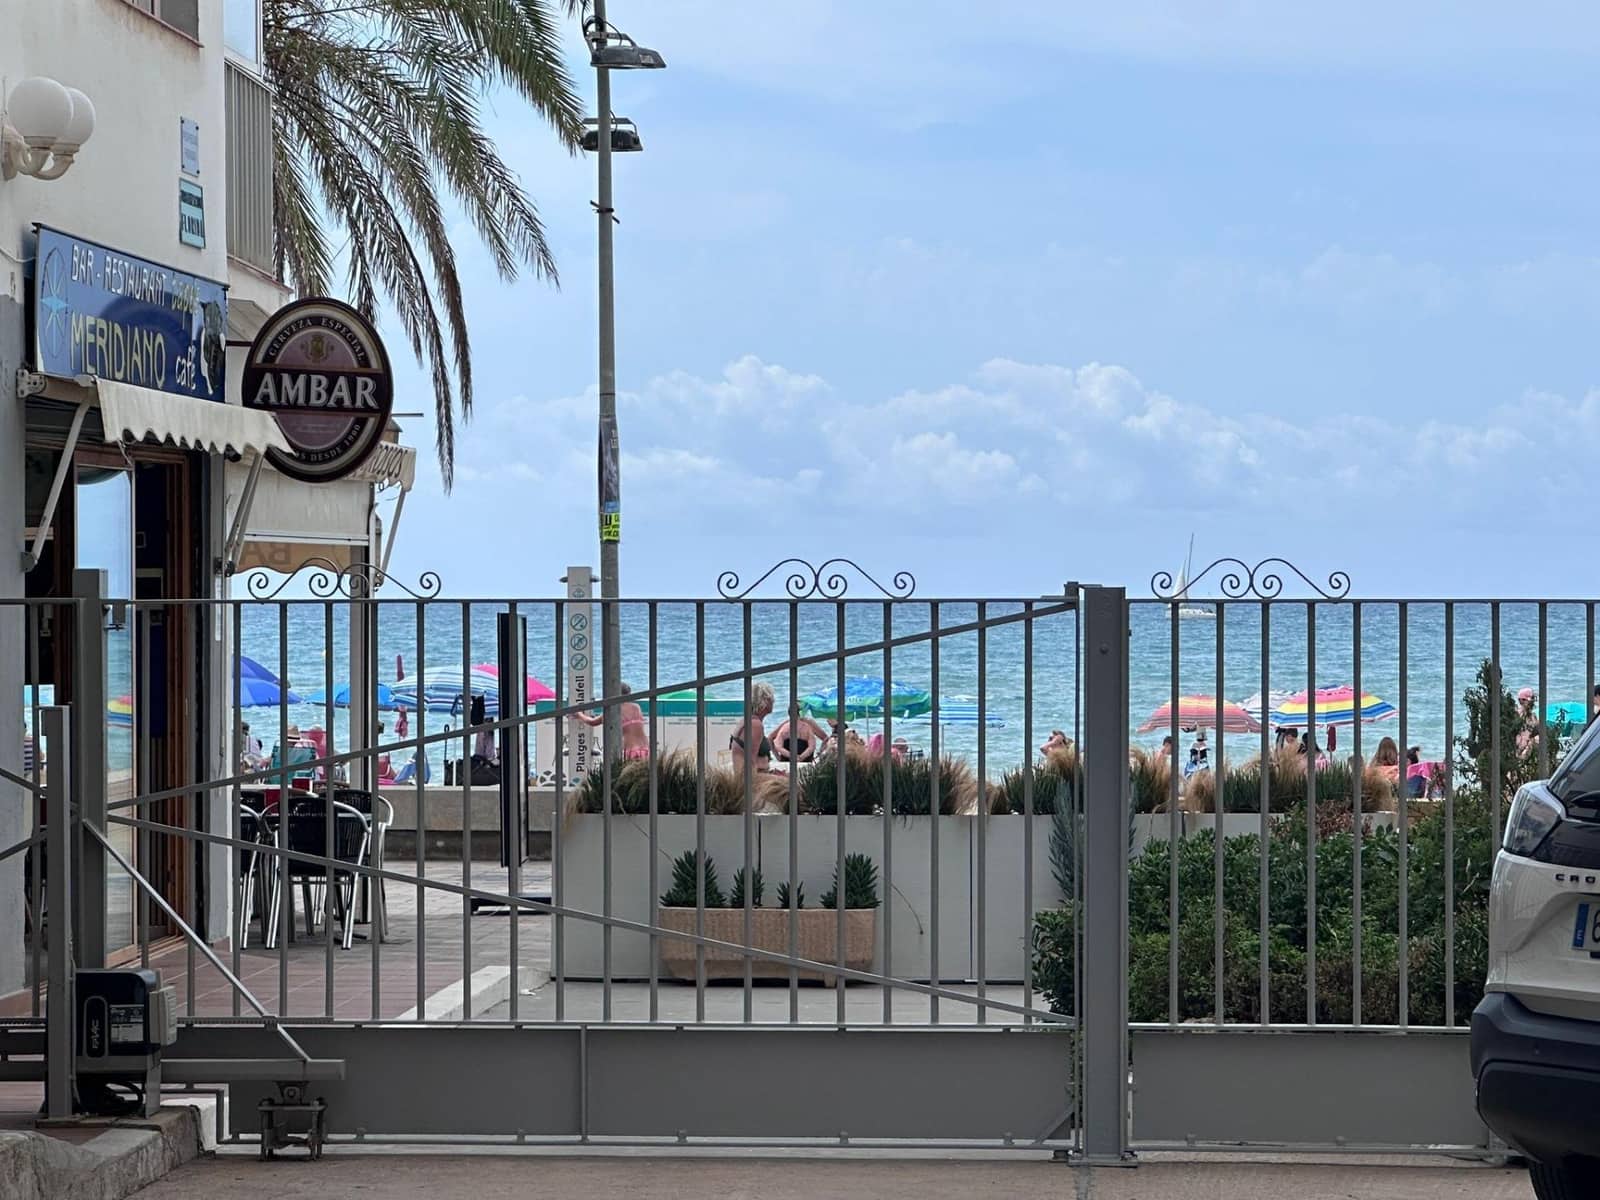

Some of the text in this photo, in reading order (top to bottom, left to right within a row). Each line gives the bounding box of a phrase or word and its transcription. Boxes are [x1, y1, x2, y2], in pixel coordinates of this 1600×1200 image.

[71, 244, 94, 286] BAR
[105, 255, 167, 307] RESTAURANT
[70, 311, 167, 389] MERIDIANO
[269, 317, 365, 362] CERVEZA ESPECIAL
[253, 372, 380, 409] AMBAR
[575, 675, 585, 707] lafell
[575, 732, 588, 772] Platges
